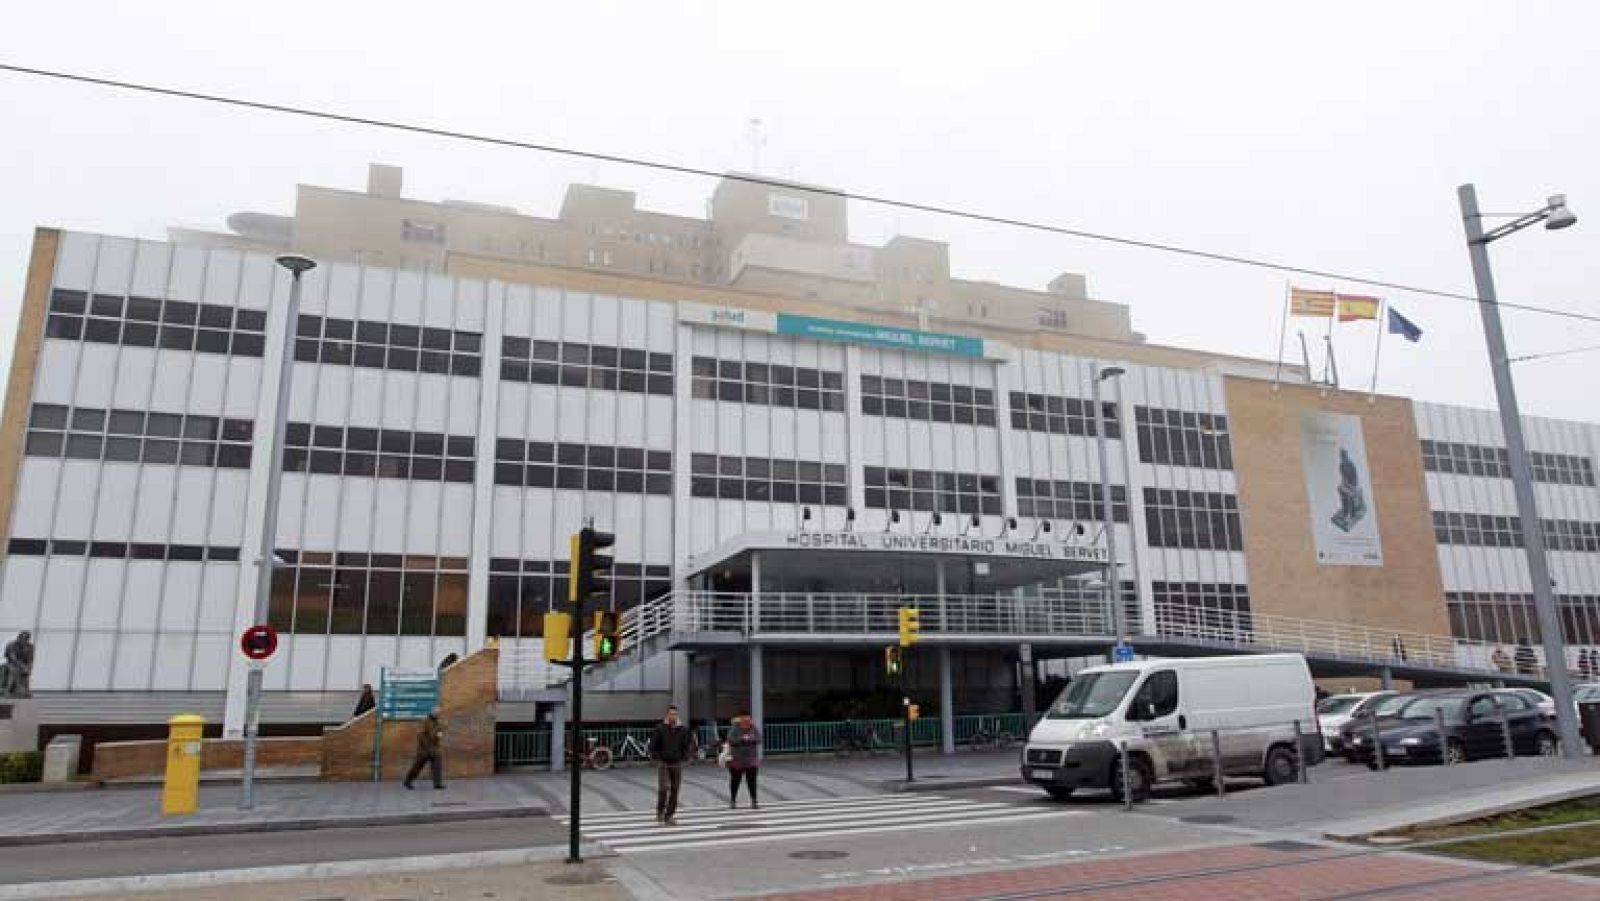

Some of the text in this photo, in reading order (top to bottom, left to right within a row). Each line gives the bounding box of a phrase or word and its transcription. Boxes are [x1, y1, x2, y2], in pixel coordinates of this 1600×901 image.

[787, 532, 867, 548] HOSPITAL
[882, 537, 995, 553] UNIVERSITARIO
[1006, 541, 1050, 557] MIGUEL
